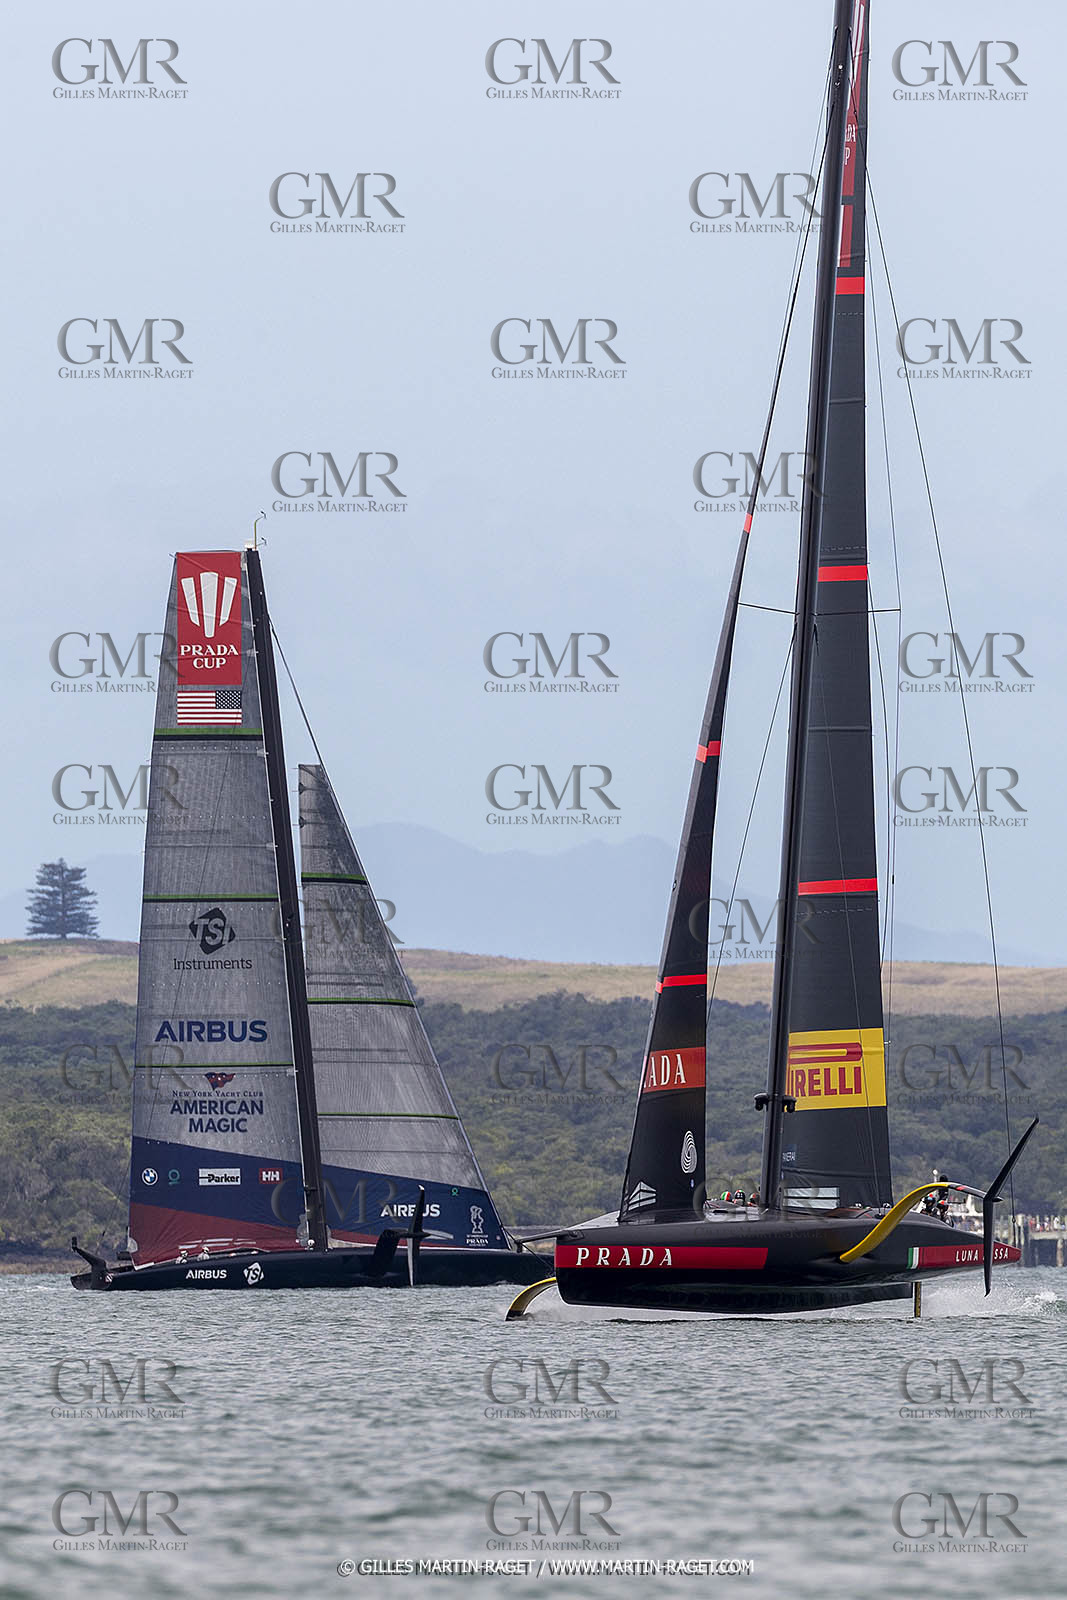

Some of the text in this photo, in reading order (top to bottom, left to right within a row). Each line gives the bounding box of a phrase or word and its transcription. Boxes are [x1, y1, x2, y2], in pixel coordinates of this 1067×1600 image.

[180, 644, 239, 656] PRADA
[193, 658, 226, 669] CUP
[192, 916, 233, 948] TSI
[173, 958, 253, 970] Instruments
[155, 1020, 268, 1042] AIRBUS
[643, 1053, 687, 1088] ADA
[170, 1100, 264, 1115] AMERICAN
[188, 1118, 248, 1133] MAGIC
[206, 1173, 240, 1184] Parker
[262, 1170, 280, 1182] HH
[575, 1247, 673, 1266] PRADA
[955, 1247, 1009, 1262] LUNA SSA
[185, 1269, 227, 1279] AIRBUS
